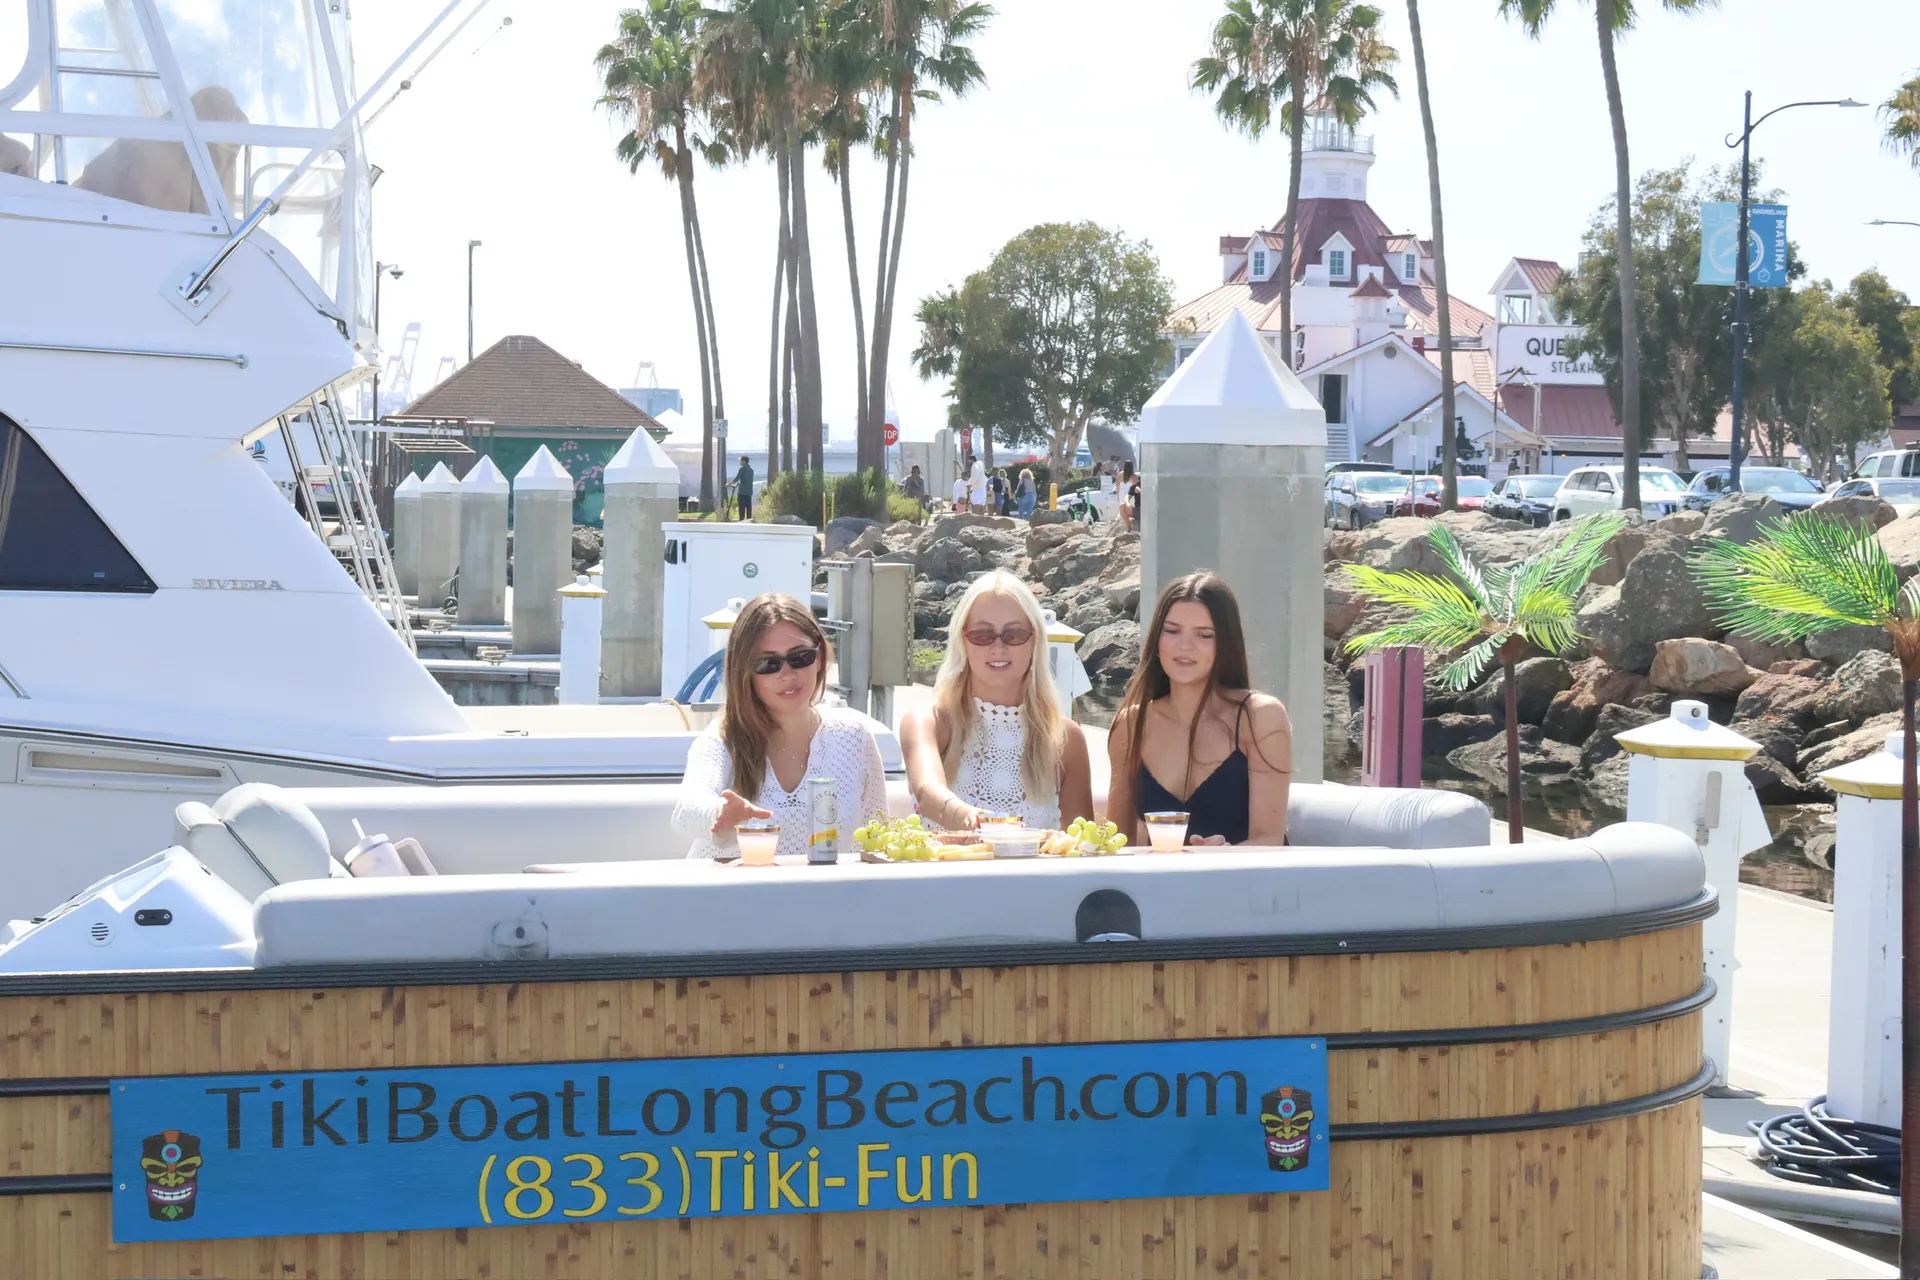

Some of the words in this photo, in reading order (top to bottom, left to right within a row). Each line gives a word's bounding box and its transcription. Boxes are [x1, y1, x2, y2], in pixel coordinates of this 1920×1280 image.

[1752, 208, 1787, 216] SHORELINE
[1775, 219, 1785, 272] MARINA
[1526, 337, 1566, 357] QUE
[1551, 361, 1594, 373] STEAKH
[884, 430, 898, 440] TOP
[191, 578, 285, 591] RIVIERA
[205, 1056, 1248, 1150] TikiBoatLongBeach.com
